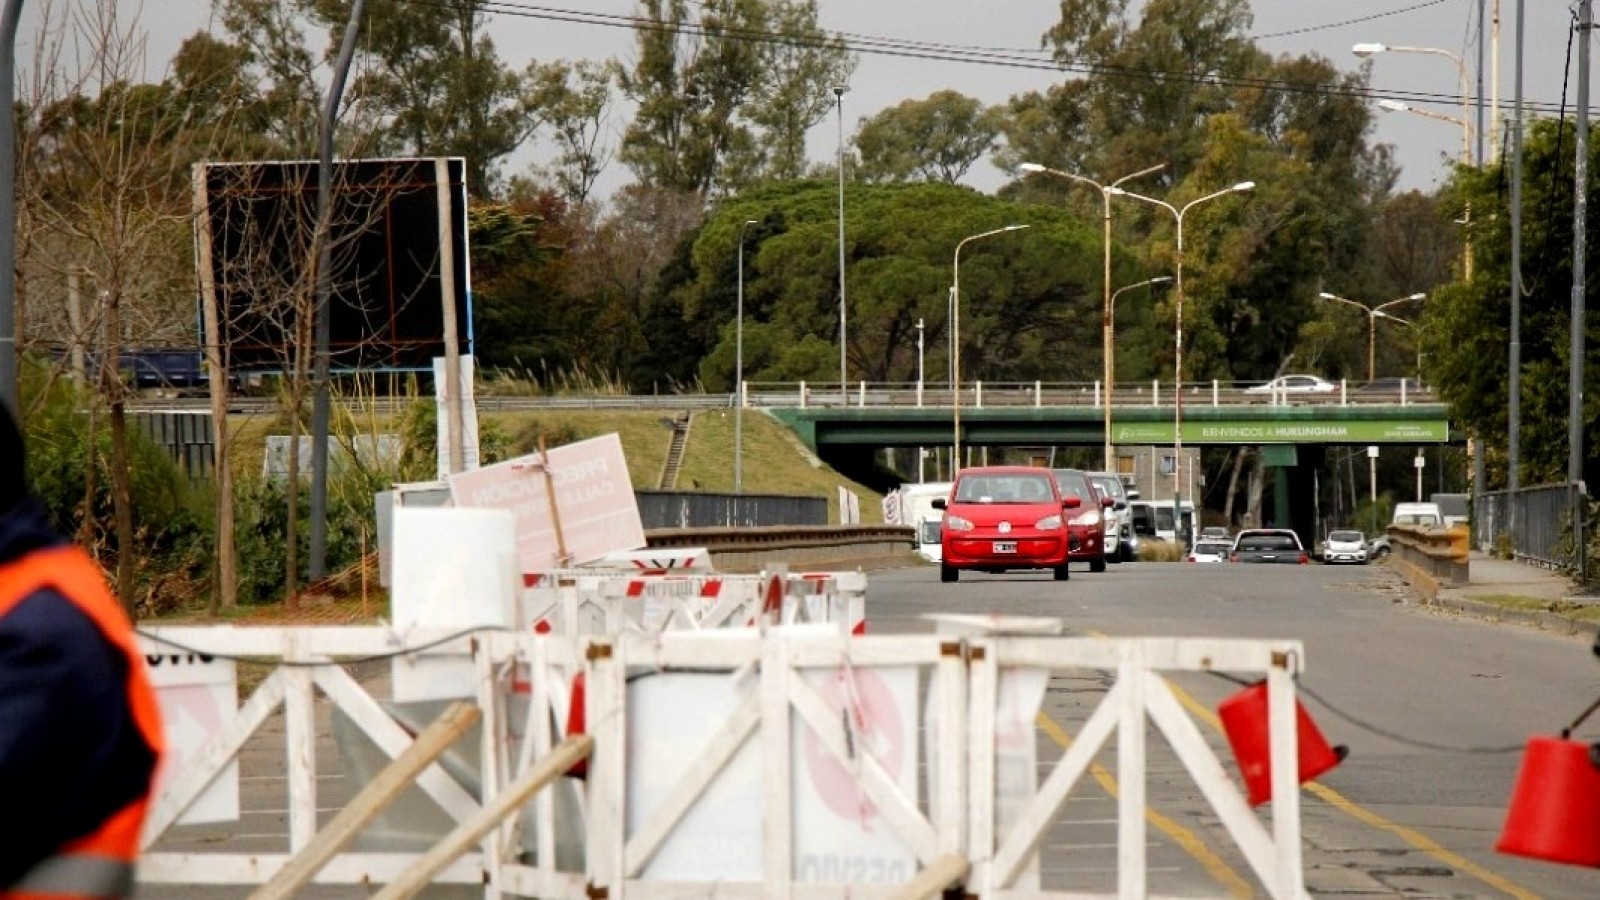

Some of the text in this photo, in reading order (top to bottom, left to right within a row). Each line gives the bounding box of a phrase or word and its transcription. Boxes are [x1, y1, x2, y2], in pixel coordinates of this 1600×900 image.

[1202, 426, 1347, 437] BIENVENIDOS A HURLINGHAM
